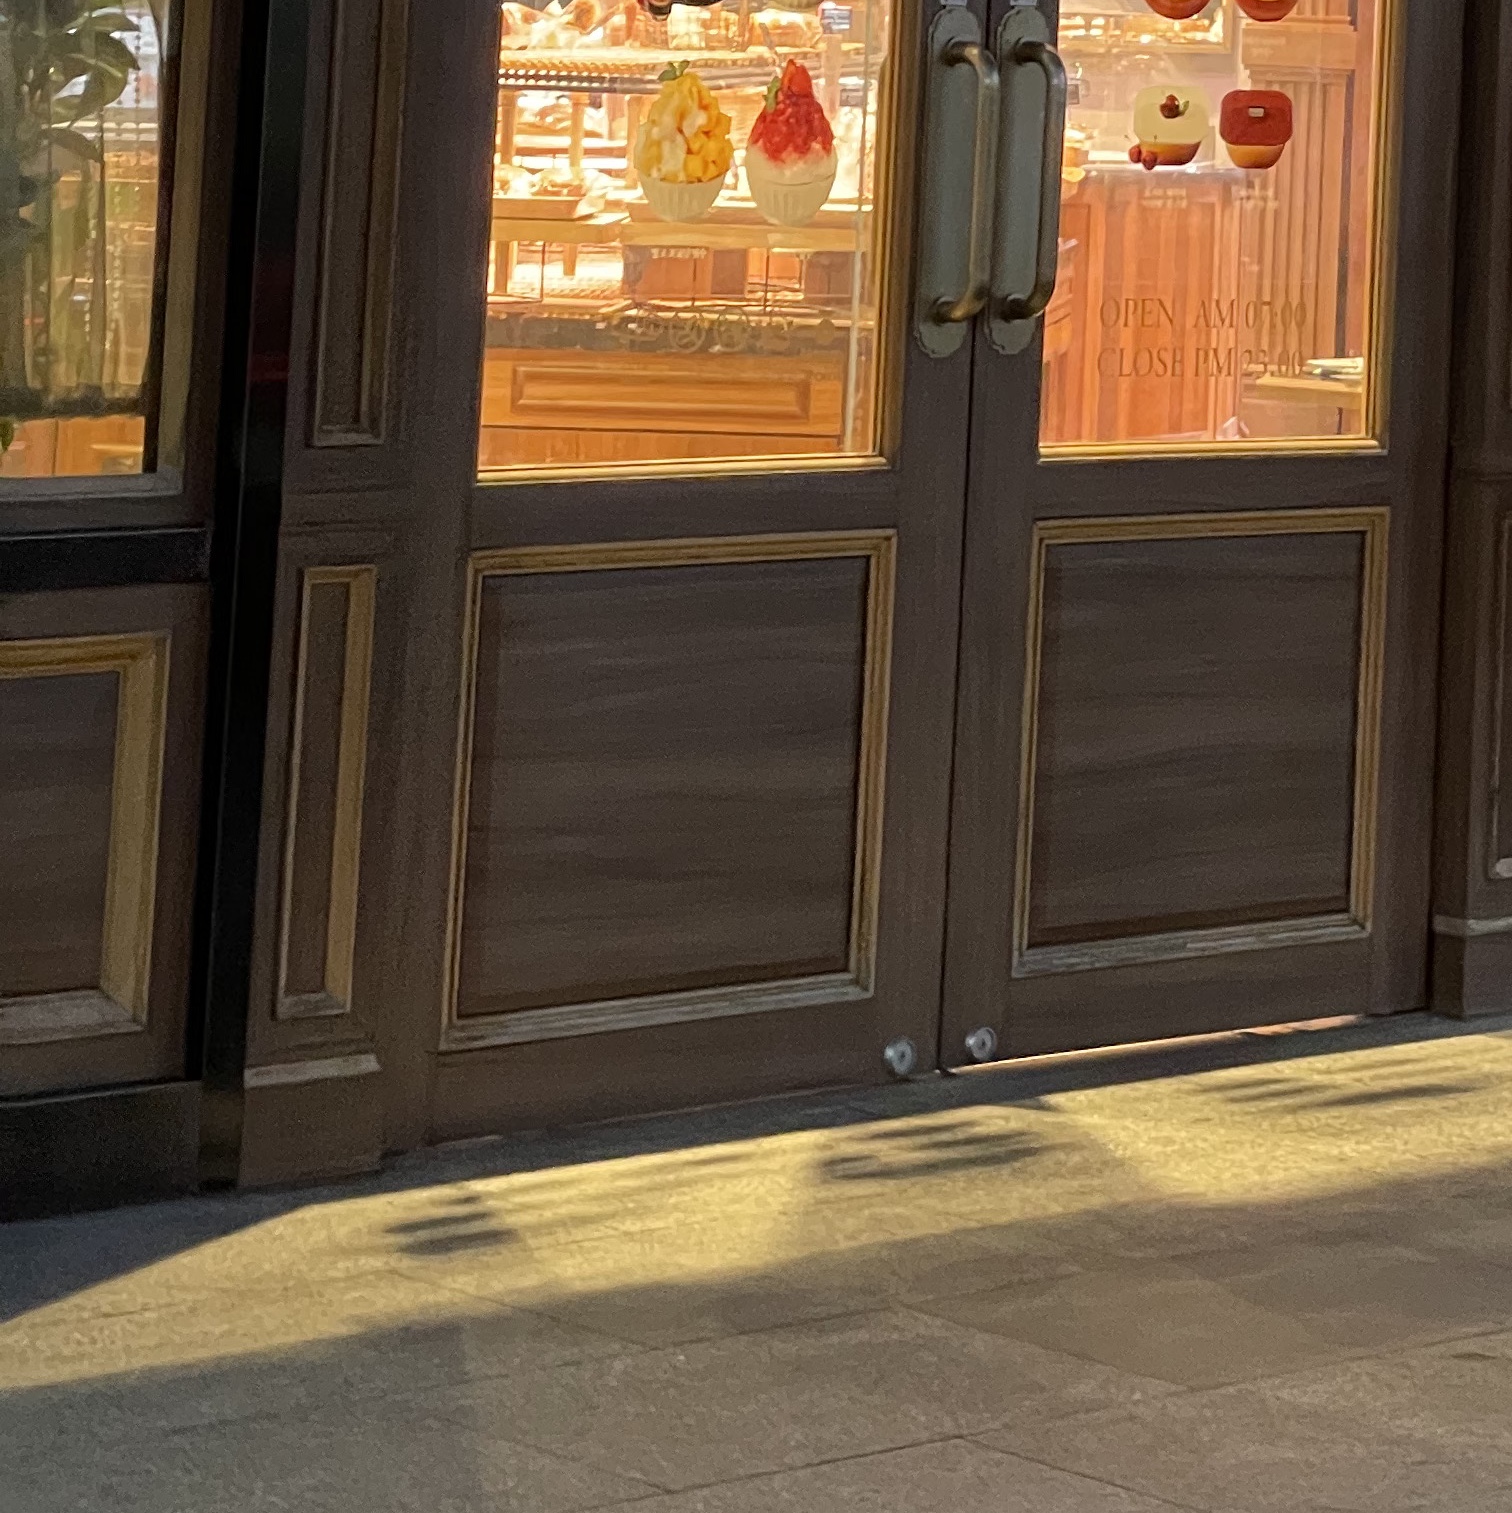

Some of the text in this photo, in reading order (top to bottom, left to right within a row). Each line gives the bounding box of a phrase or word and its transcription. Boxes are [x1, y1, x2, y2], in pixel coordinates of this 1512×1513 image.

[1099, 297, 1173, 328] OPEN
[1193, 299, 1236, 328] AM
[1097, 348, 1184, 378] CLOSE
[1194, 348, 1235, 378] PM
